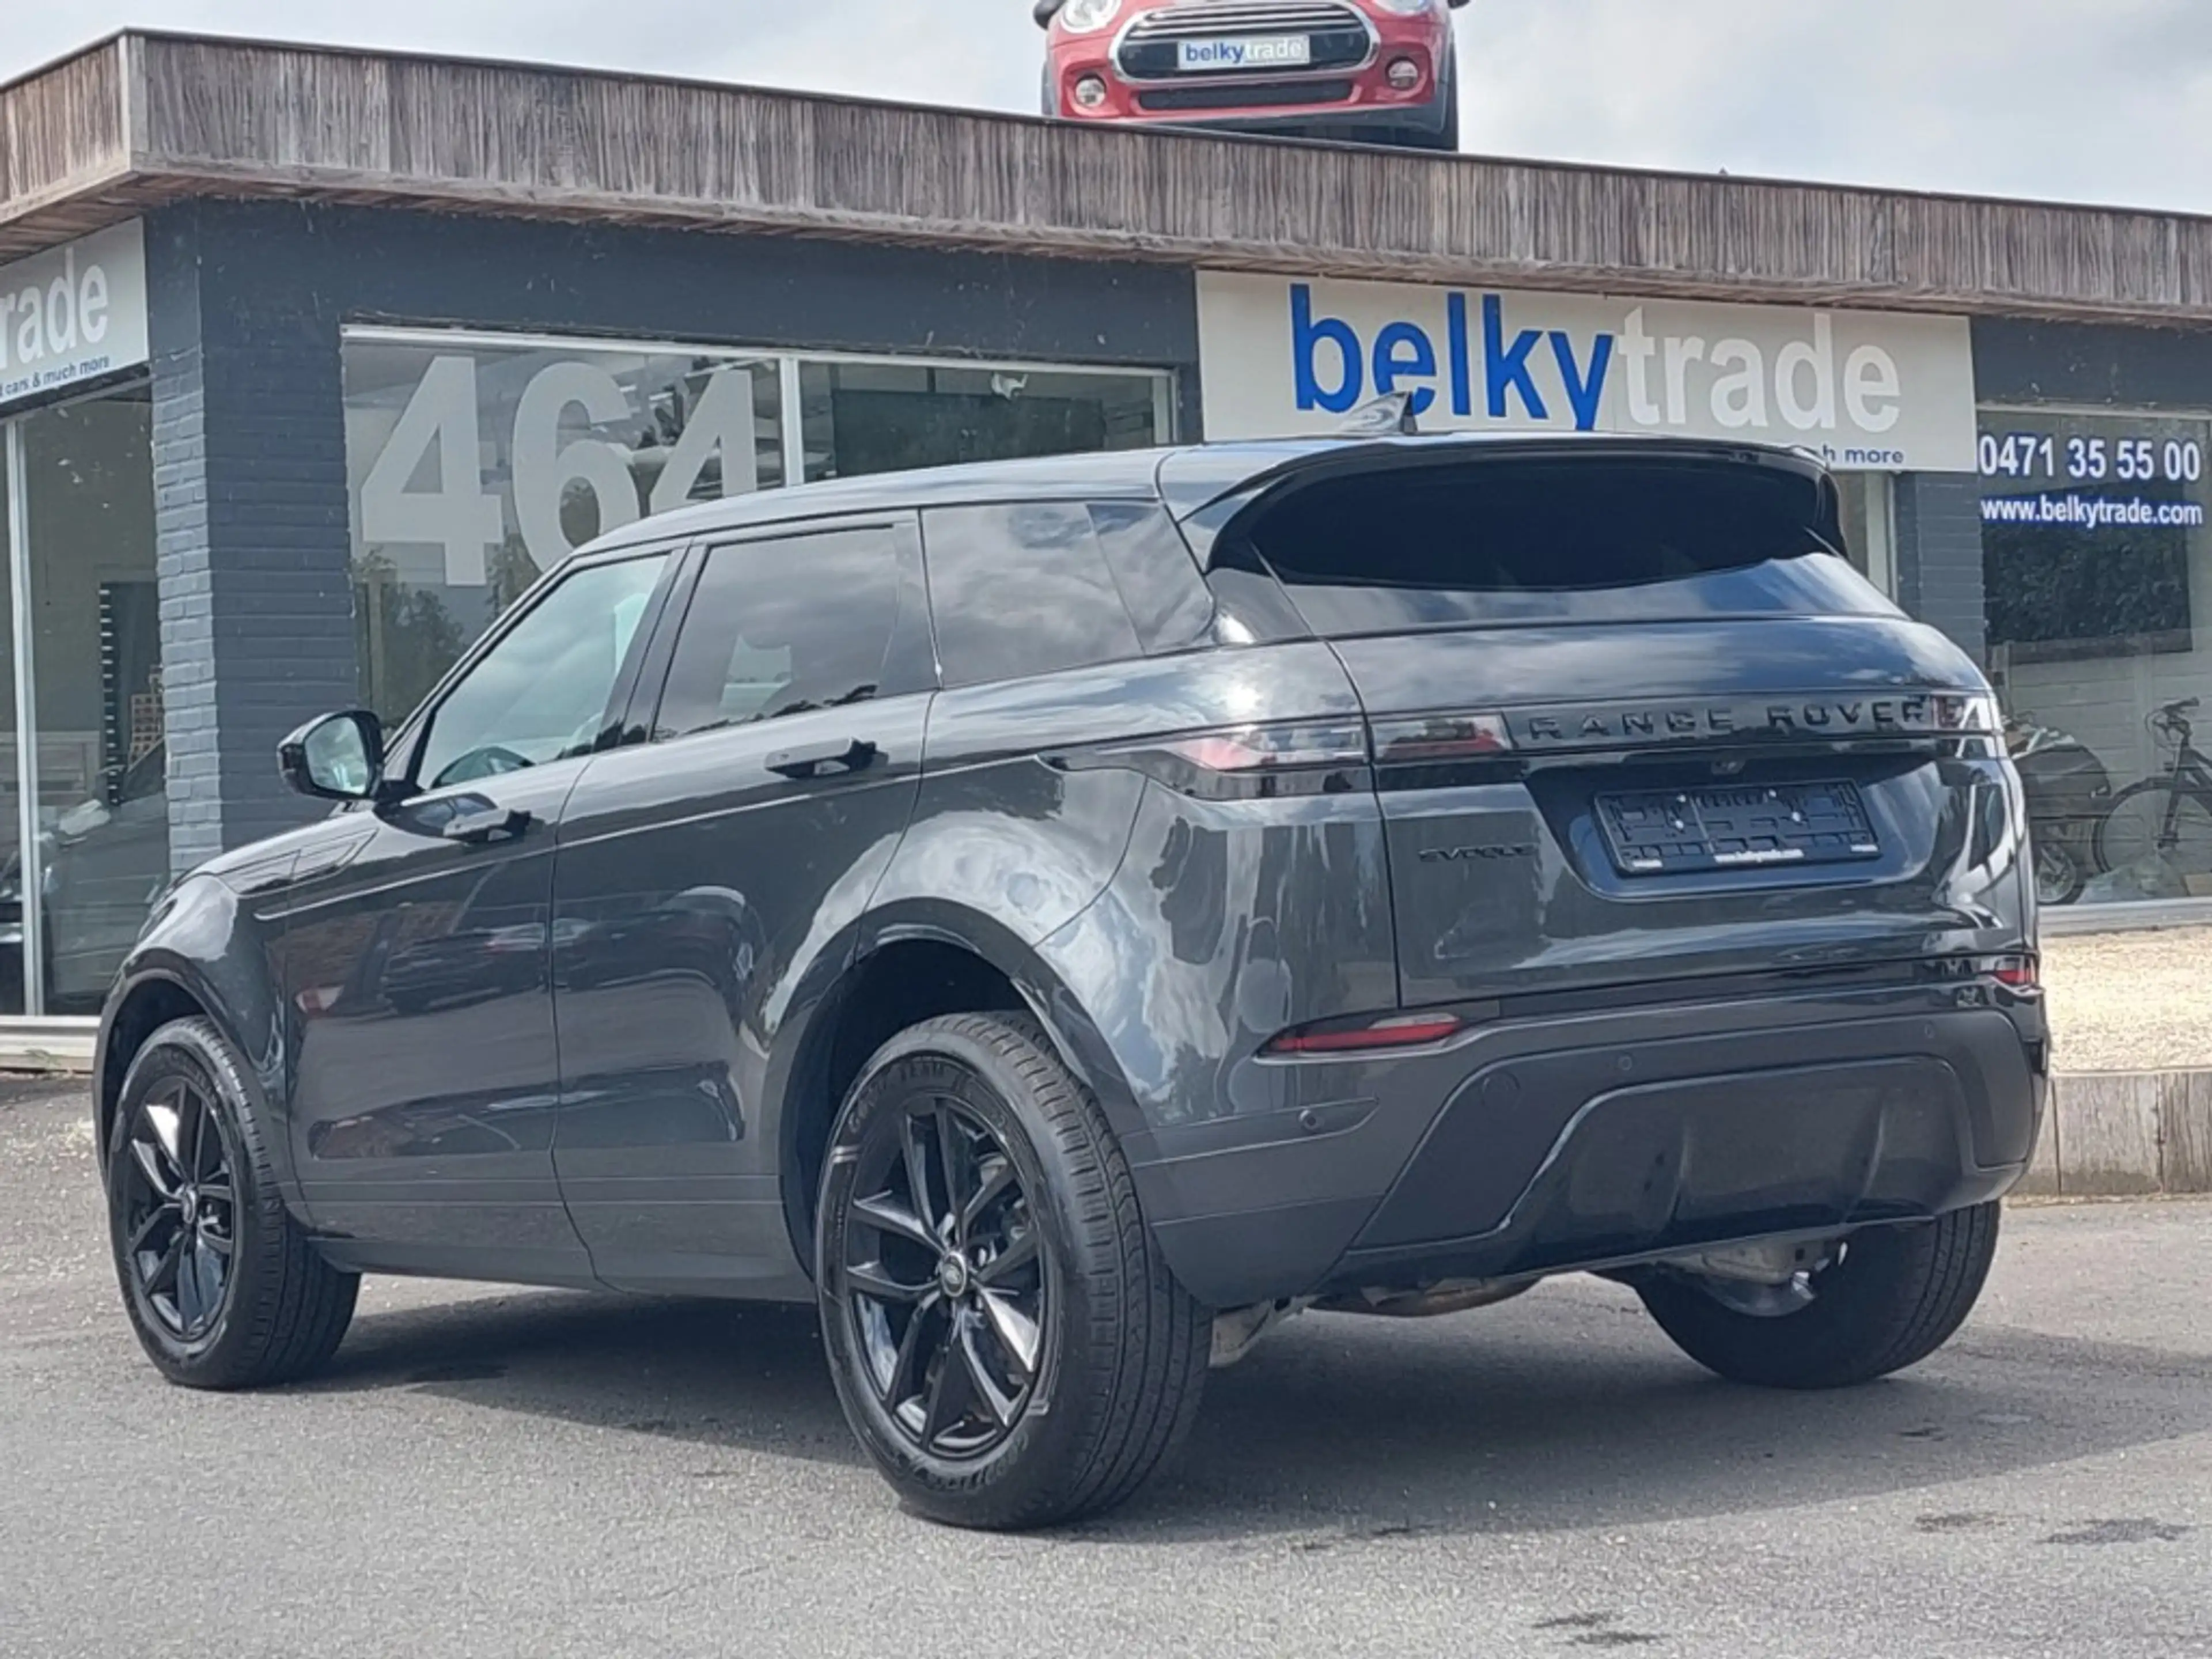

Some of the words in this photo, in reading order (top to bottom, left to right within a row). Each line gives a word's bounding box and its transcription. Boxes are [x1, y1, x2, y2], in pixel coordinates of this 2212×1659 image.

[1186, 39, 1302, 63] belkytrade
[1290, 283, 1900, 433] belkytrade
[361, 355, 757, 586] 464
[1844, 448, 1904, 464] more
[1979, 435, 2054, 476] 0471
[2067, 438, 2106, 478] 35
[2117, 440, 2154, 480] 55
[2164, 441, 2200, 481] 00
[1980, 494, 2202, 528] www.belkytrade.com
[1528, 709, 1733, 741] RANGE
[1767, 699, 1924, 728] ROVER
